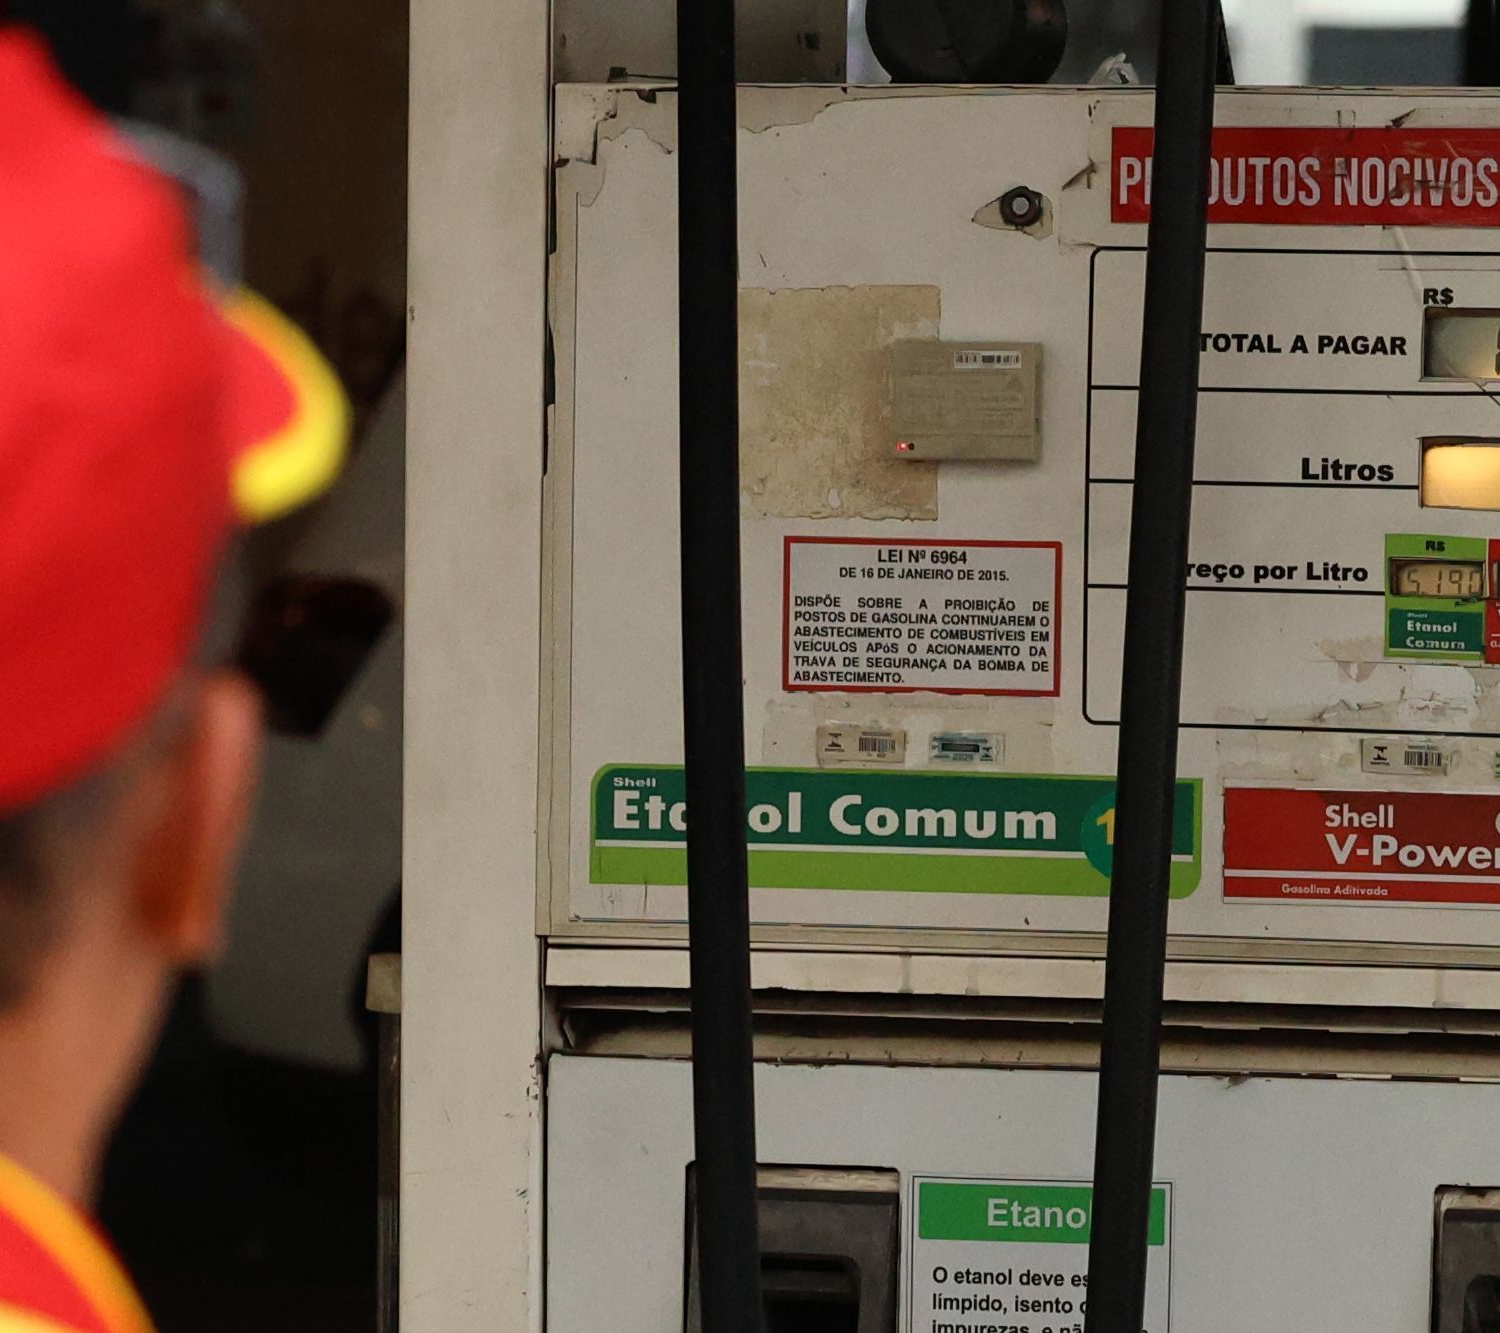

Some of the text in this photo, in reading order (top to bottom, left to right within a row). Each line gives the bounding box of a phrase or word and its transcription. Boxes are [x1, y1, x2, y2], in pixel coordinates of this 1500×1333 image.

[1119, 156, 1321, 206] PUTOS
[1334, 156, 1498, 207] NOCIVOS
[1423, 288, 1454, 306] R$
[1200, 333, 1408, 356] TOTAL A PAGAR
[1301, 457, 1395, 482] Litros
[878, 549, 967, 565] LEI 6964
[898, 568, 1009, 581] JANEIRO 2015.
[1186, 560, 1368, 585] reço por Litro
[858, 597, 1016, 613] SOBRE PROIBIÇÃO
[794, 611, 1036, 627] POSTOS GASOLINA CONTINUAREM
[794, 626, 1026, 641] ABASTECIMENTO COMBUSTÍVEIS
[794, 639, 1020, 657] VEÍCULOS ACIONAMENTO
[794, 656, 1026, 672] TRAVA SEGURANÇA BOMBA
[793, 671, 906, 684] ABASTECIMENTO.
[613, 777, 656, 788] Shell
[613, 790, 1057, 841] Etol Comum
[1325, 804, 1394, 829] Shell
[1281, 882, 1388, 897] Gasolina Aditivada
[987, 1197, 1092, 1230] Etano
[932, 1266, 948, 1285] O
[954, 1268, 1012, 1286] etanol
[1019, 1270, 1065, 1287] deve
[932, 1293, 1008, 1314] límpido,
[1014, 1295, 1073, 1315] isento
